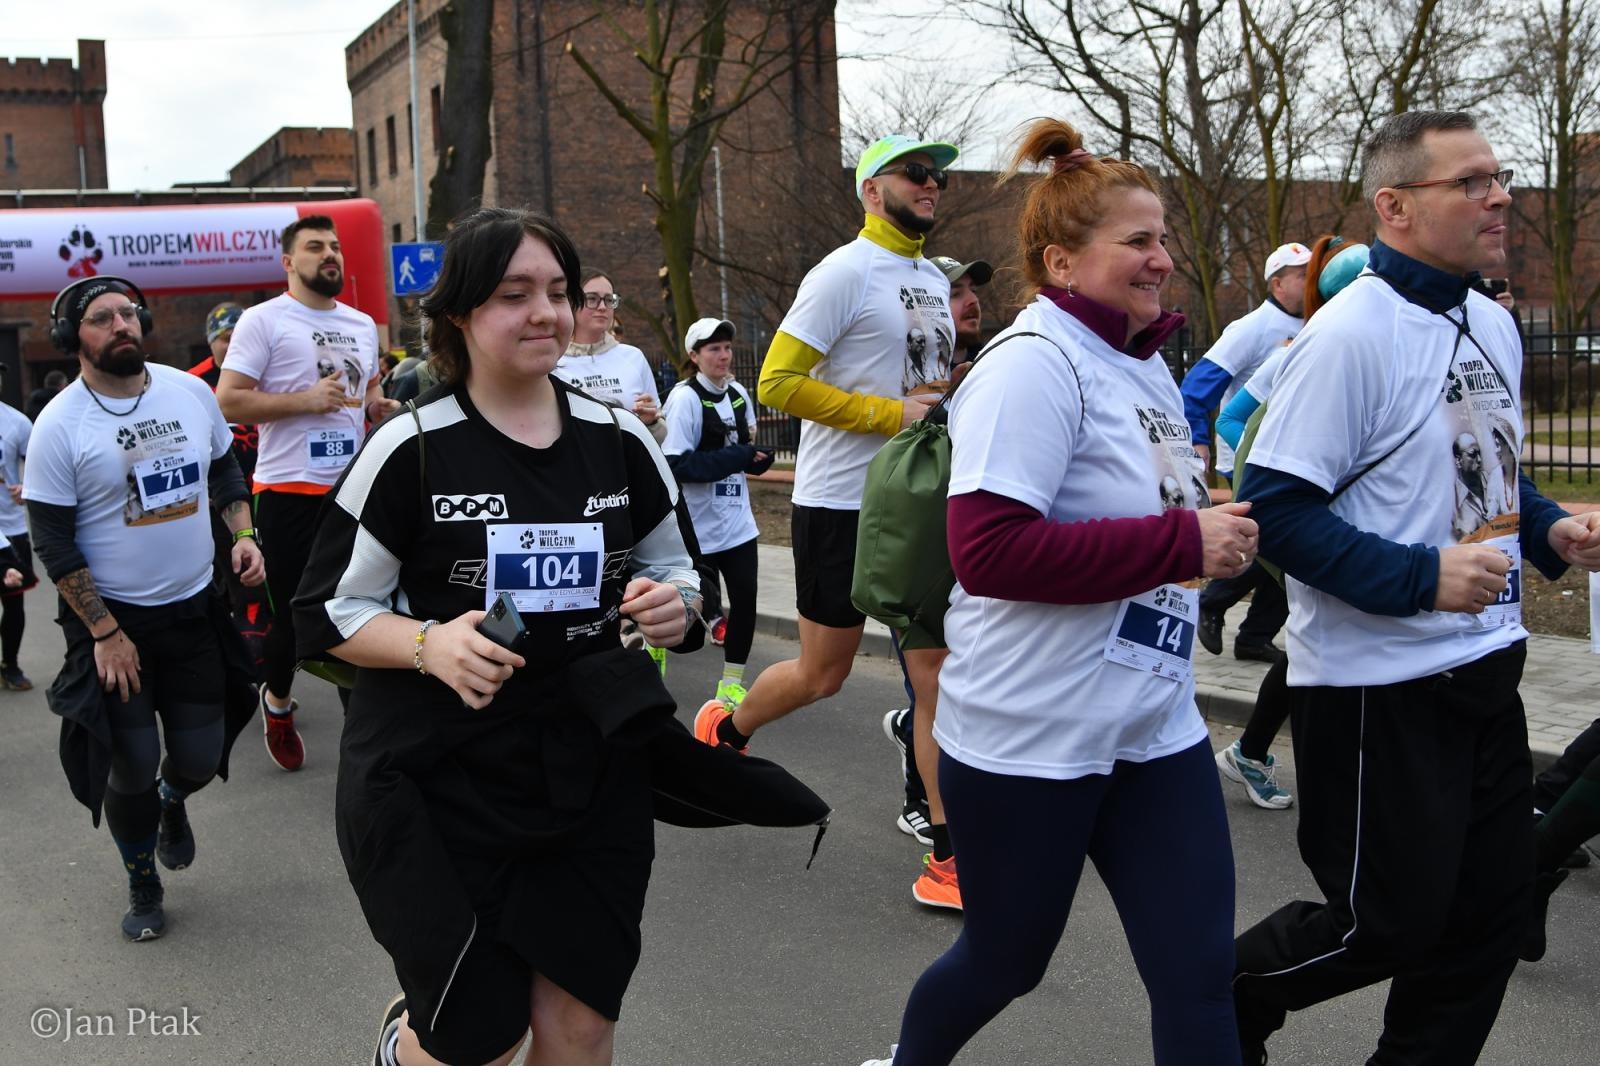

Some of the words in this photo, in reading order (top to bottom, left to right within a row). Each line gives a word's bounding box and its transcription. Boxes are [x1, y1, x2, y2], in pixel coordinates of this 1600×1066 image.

[137, 420, 183, 440] WILCZYM
[326, 441, 344, 456] 88
[161, 468, 185, 490] 71
[726, 484, 737, 496] 84
[439, 500, 501, 515] BPM
[539, 536, 576, 547] WILCZYM
[521, 554, 582, 587] 104
[1499, 572, 1513, 602] 5
[1156, 616, 1184, 653] 14
